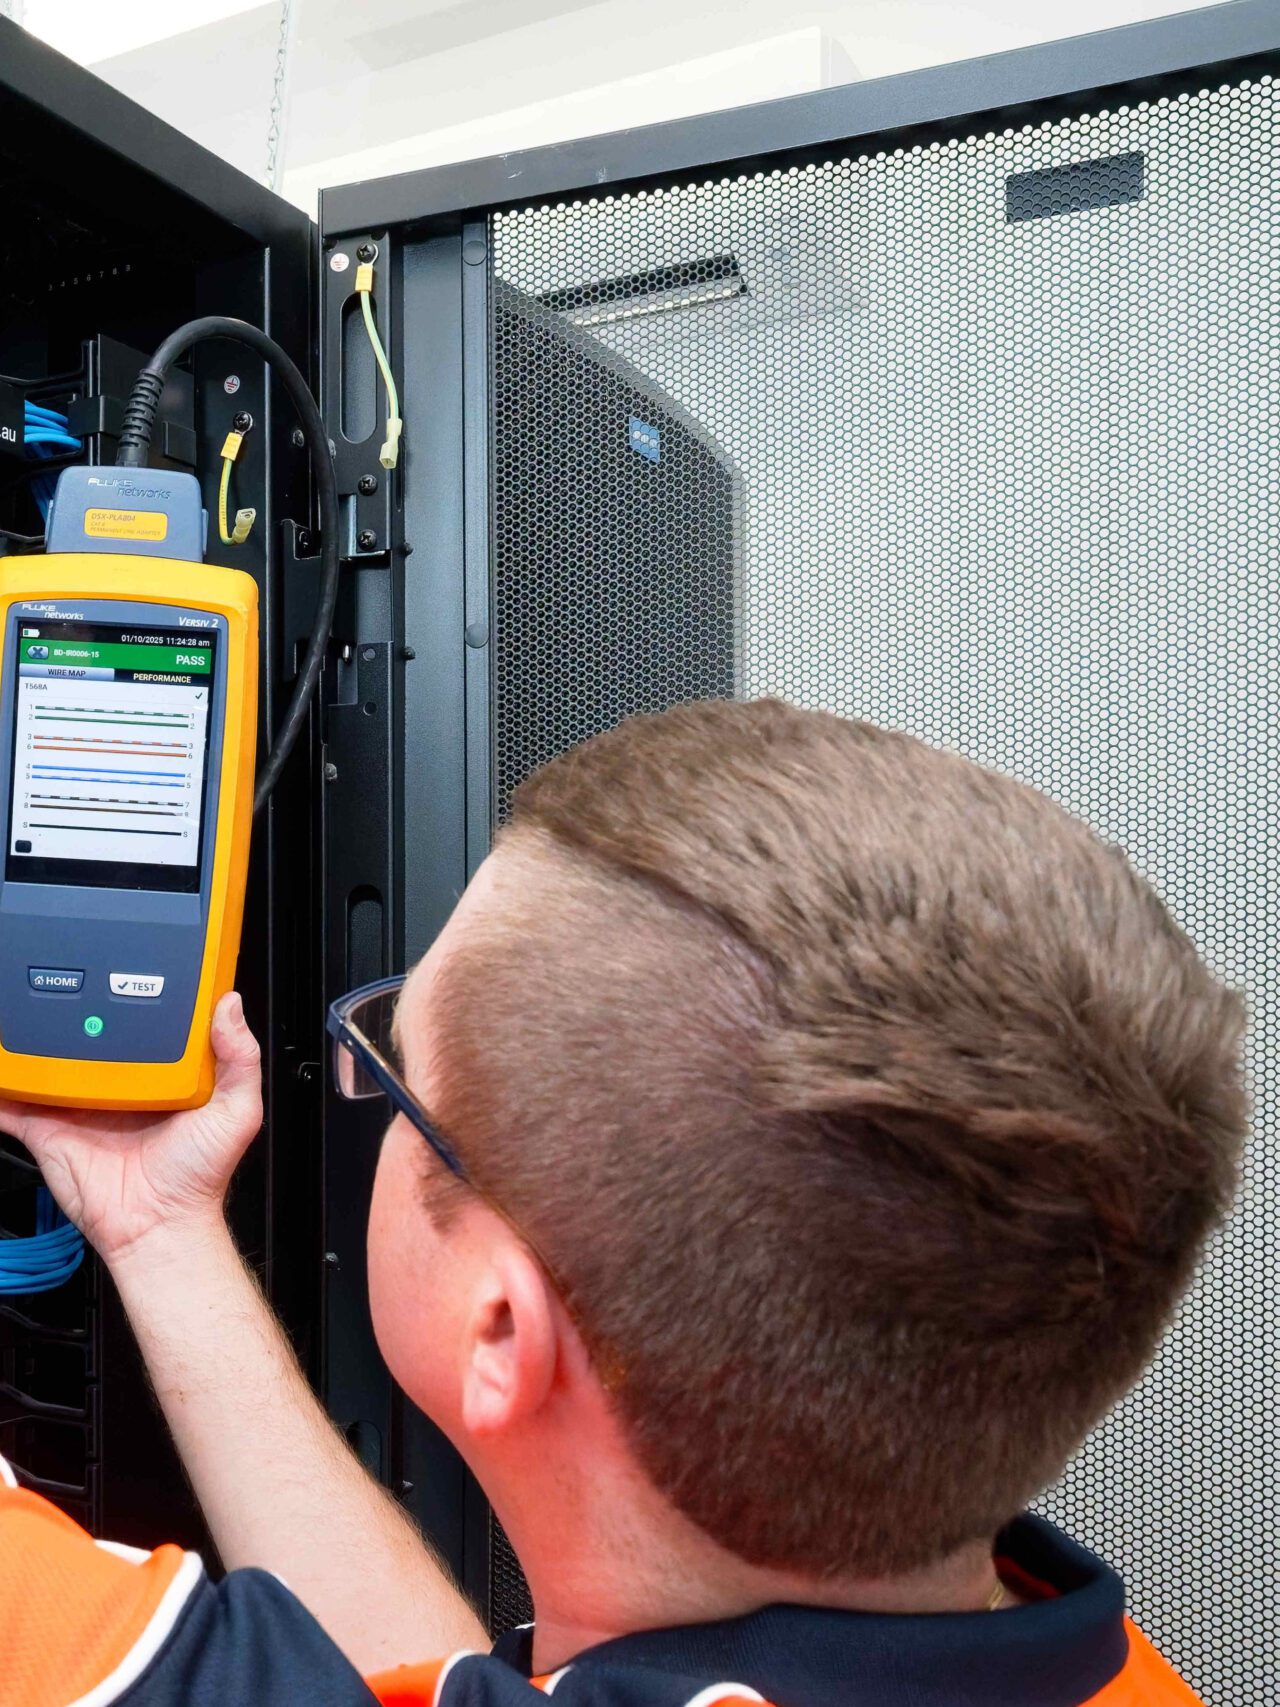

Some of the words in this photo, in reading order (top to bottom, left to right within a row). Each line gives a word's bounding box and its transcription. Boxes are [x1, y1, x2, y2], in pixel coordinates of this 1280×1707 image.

[88, 477, 134, 487] FLUKE
[117, 486, 173, 500] networks
[22, 604, 56, 612] FLUKE
[44, 612, 84, 620] networks
[211, 619, 219, 628] 2
[121, 634, 163, 644] 01/10/2025
[166, 637, 197, 646] 11:24:28
[176, 655, 206, 666] PASS
[48, 668, 67, 676] WIRE
[133, 673, 192, 684] PERFORMANCE
[46, 976, 78, 987] HOME
[132, 982, 156, 992] TEST
